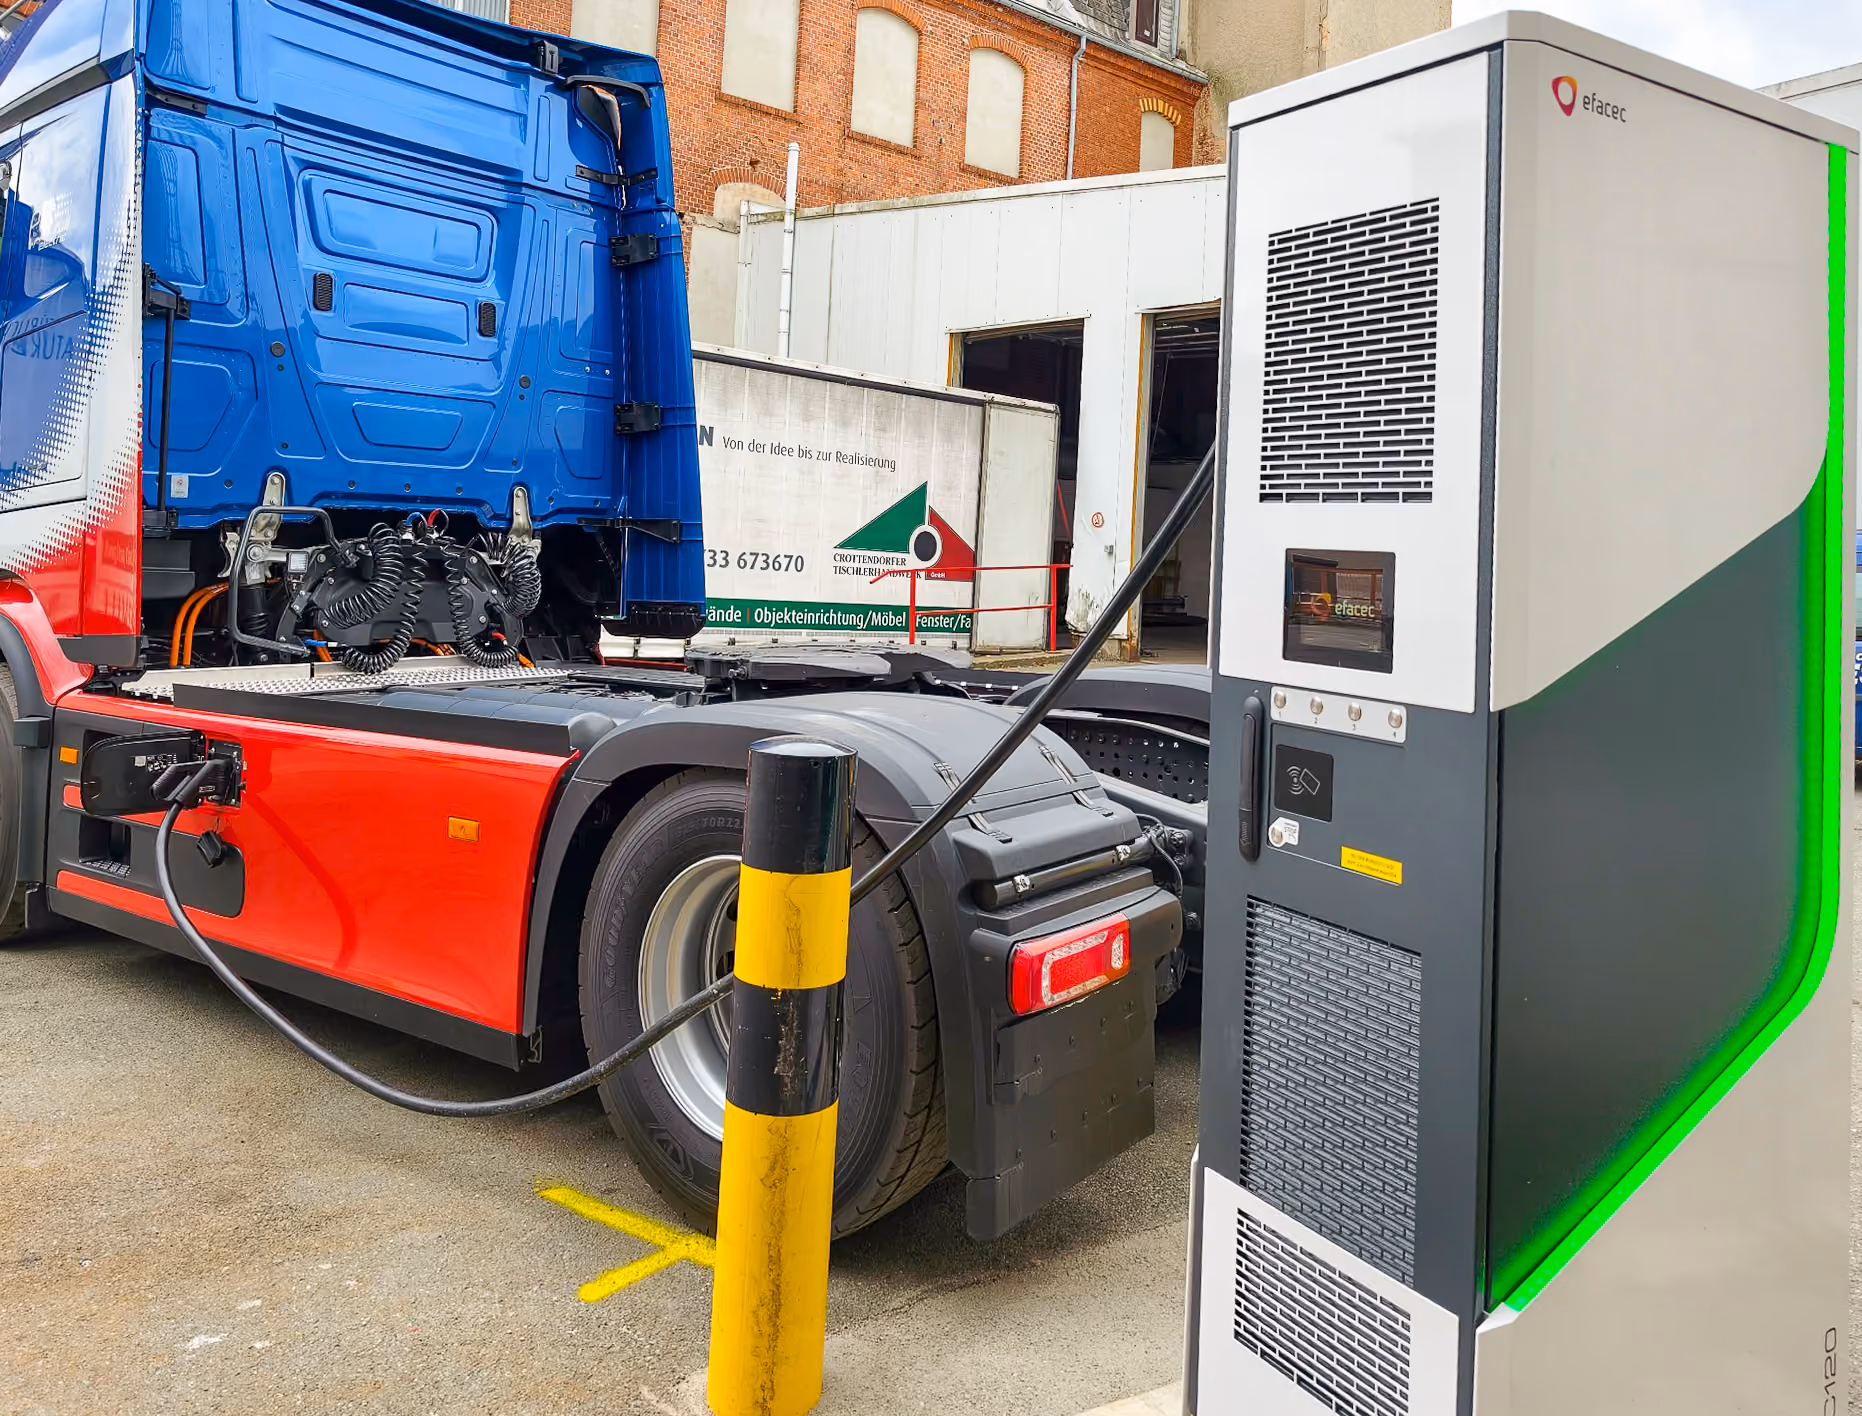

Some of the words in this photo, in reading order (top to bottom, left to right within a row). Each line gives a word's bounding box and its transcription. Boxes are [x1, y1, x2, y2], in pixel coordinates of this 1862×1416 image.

[1582, 92, 1627, 123] efacec
[722, 435, 744, 451] Von
[747, 438, 766, 454] der
[770, 442, 794, 458] Idee
[798, 445, 813, 460] bis
[816, 450, 832, 462] zur
[835, 450, 896, 473] Realisierung
[704, 548, 730, 569] 33
[736, 551, 805, 573] 673670
[833, 552, 907, 566] CROTTENDORFER
[705, 604, 742, 622] ände
[754, 606, 906, 630] Objekteinrichtung/Möbel
[1334, 600, 1376, 618] efacec
